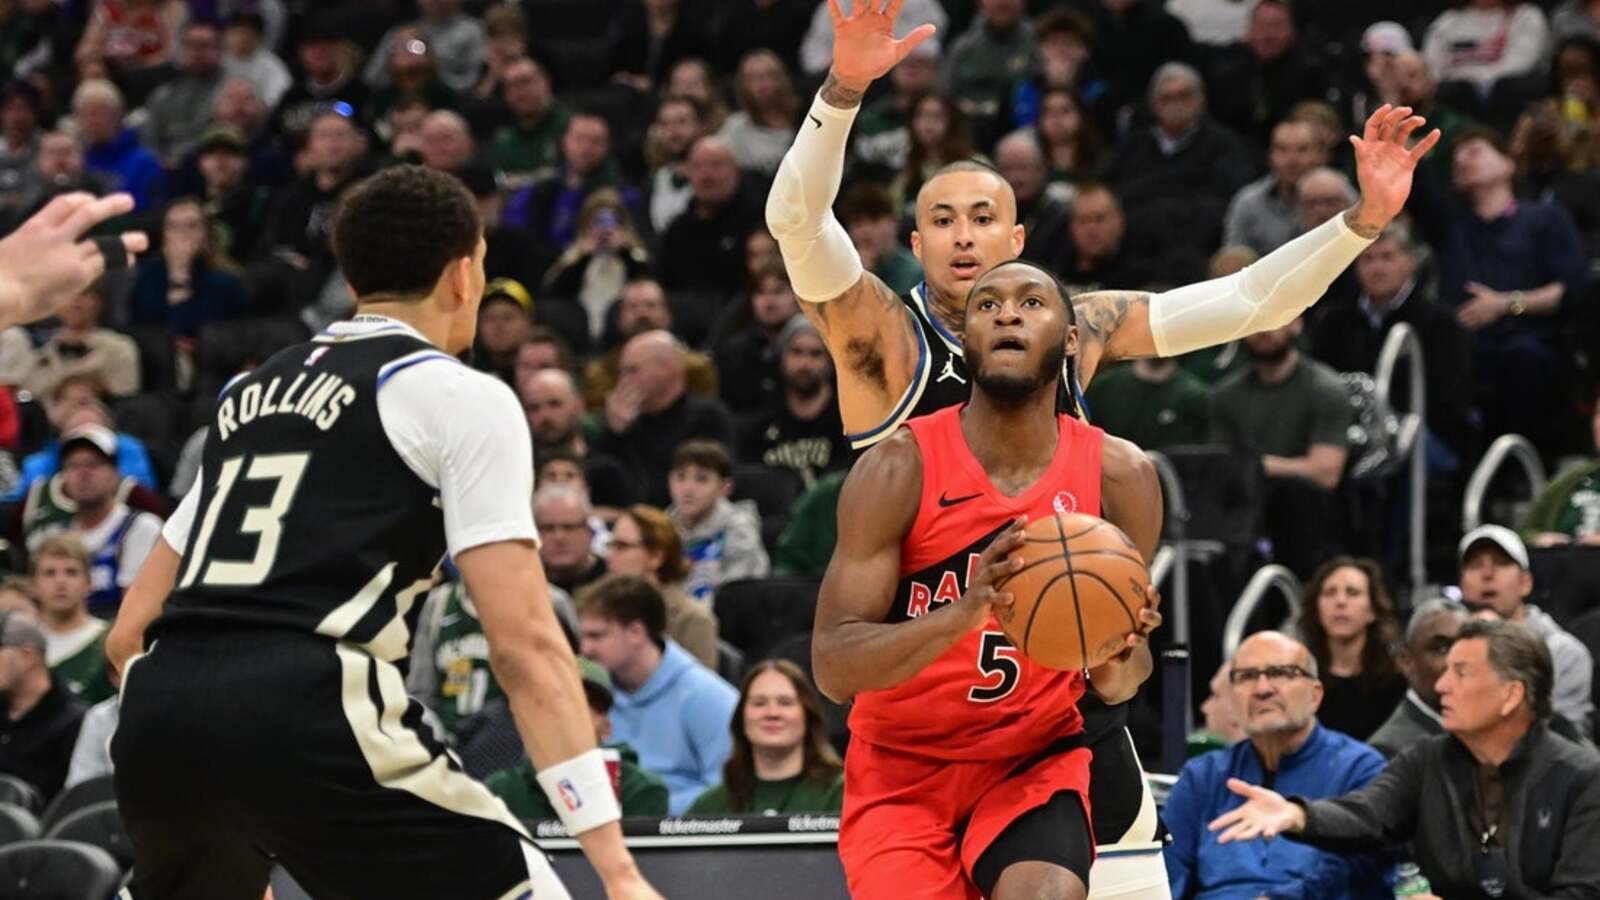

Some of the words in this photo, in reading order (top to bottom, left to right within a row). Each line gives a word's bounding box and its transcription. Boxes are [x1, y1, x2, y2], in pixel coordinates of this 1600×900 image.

[217, 372, 356, 441] ROLLINS
[178, 453, 311, 589] 13
[967, 631, 1021, 702] 5
[659, 817, 743, 834] ticketmaster
